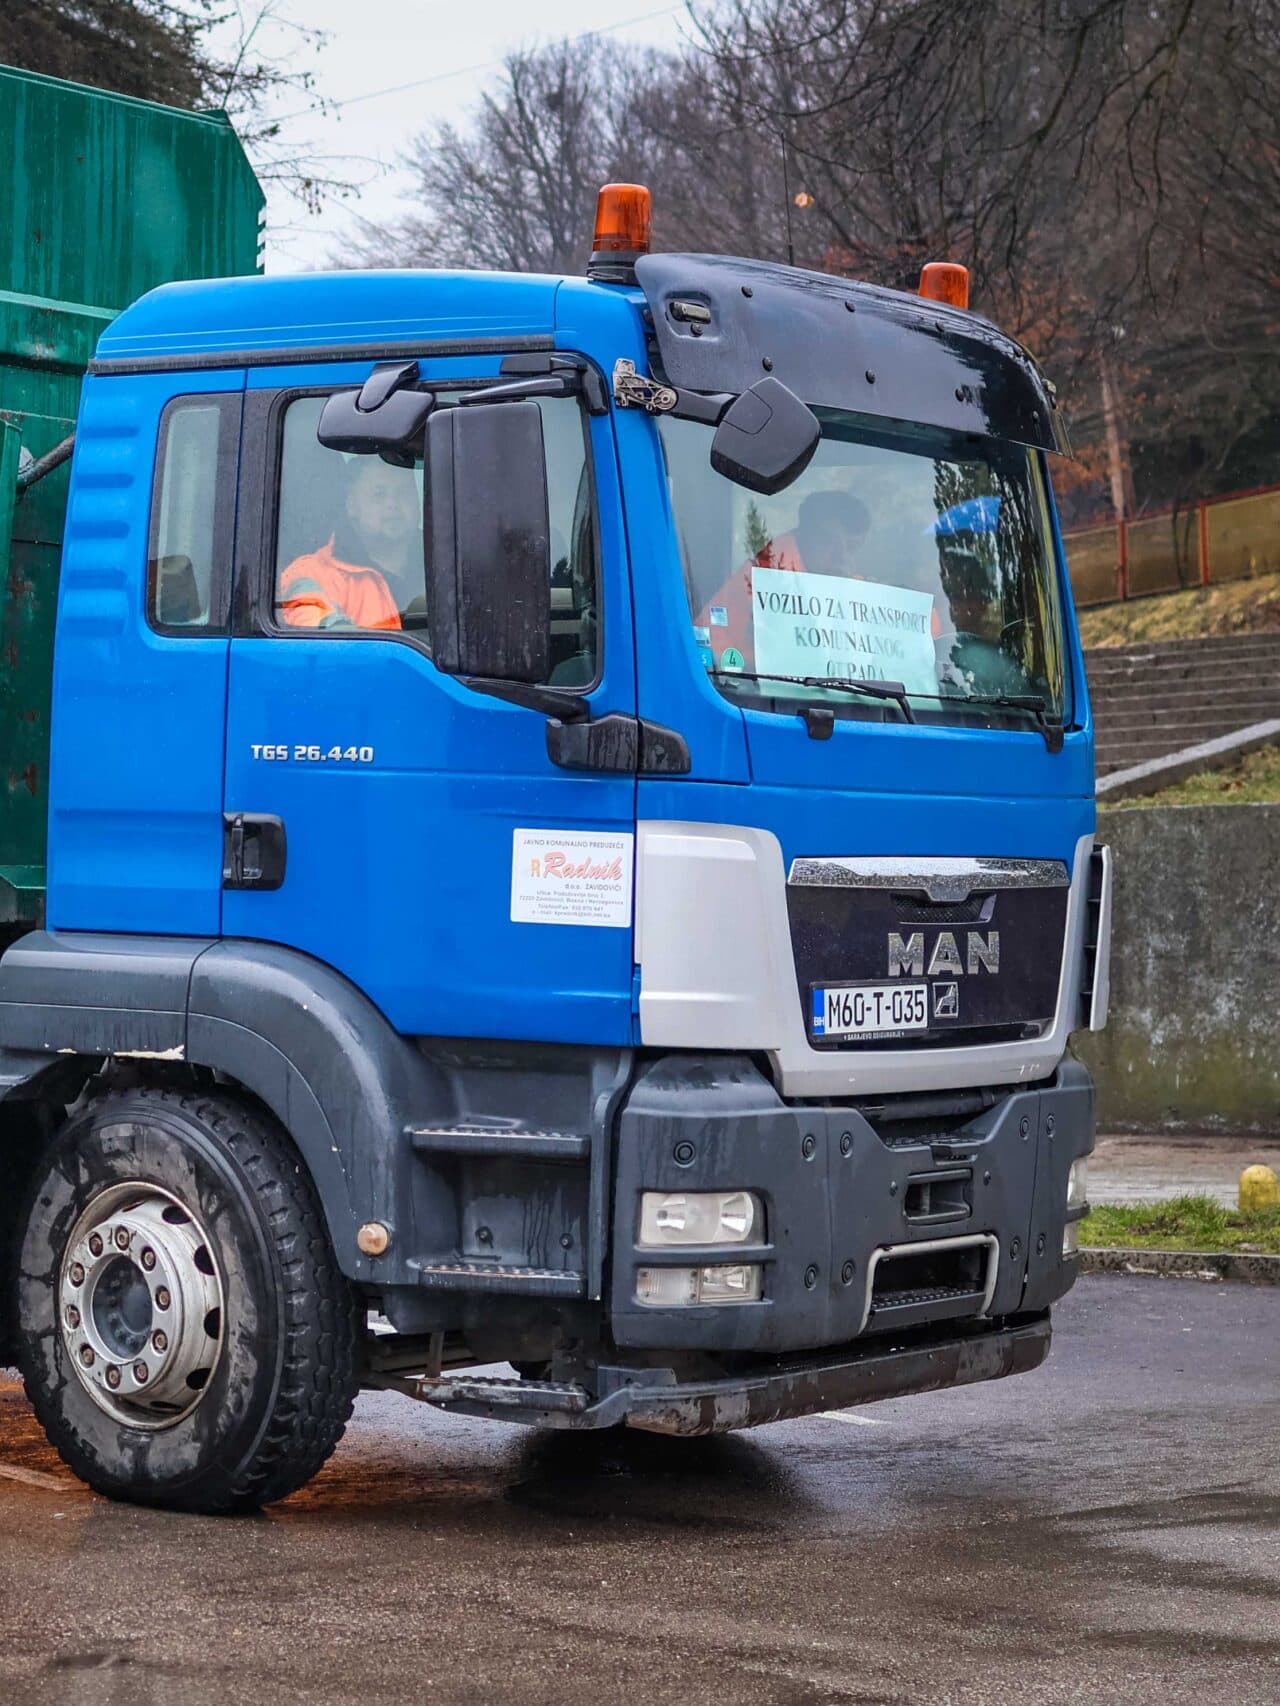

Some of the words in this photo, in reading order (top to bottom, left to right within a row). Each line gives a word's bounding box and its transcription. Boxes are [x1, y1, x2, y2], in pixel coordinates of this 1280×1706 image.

[757, 591, 821, 617] VOZILO
[825, 597, 845, 620] ZA
[849, 601, 928, 634] TRANSPORT
[729, 651, 737, 667] 4
[251, 744, 288, 761] TGS
[294, 745, 374, 762] 26.440
[887, 932, 1000, 977] MAN
[828, 989, 925, 1029] M60-T-035
